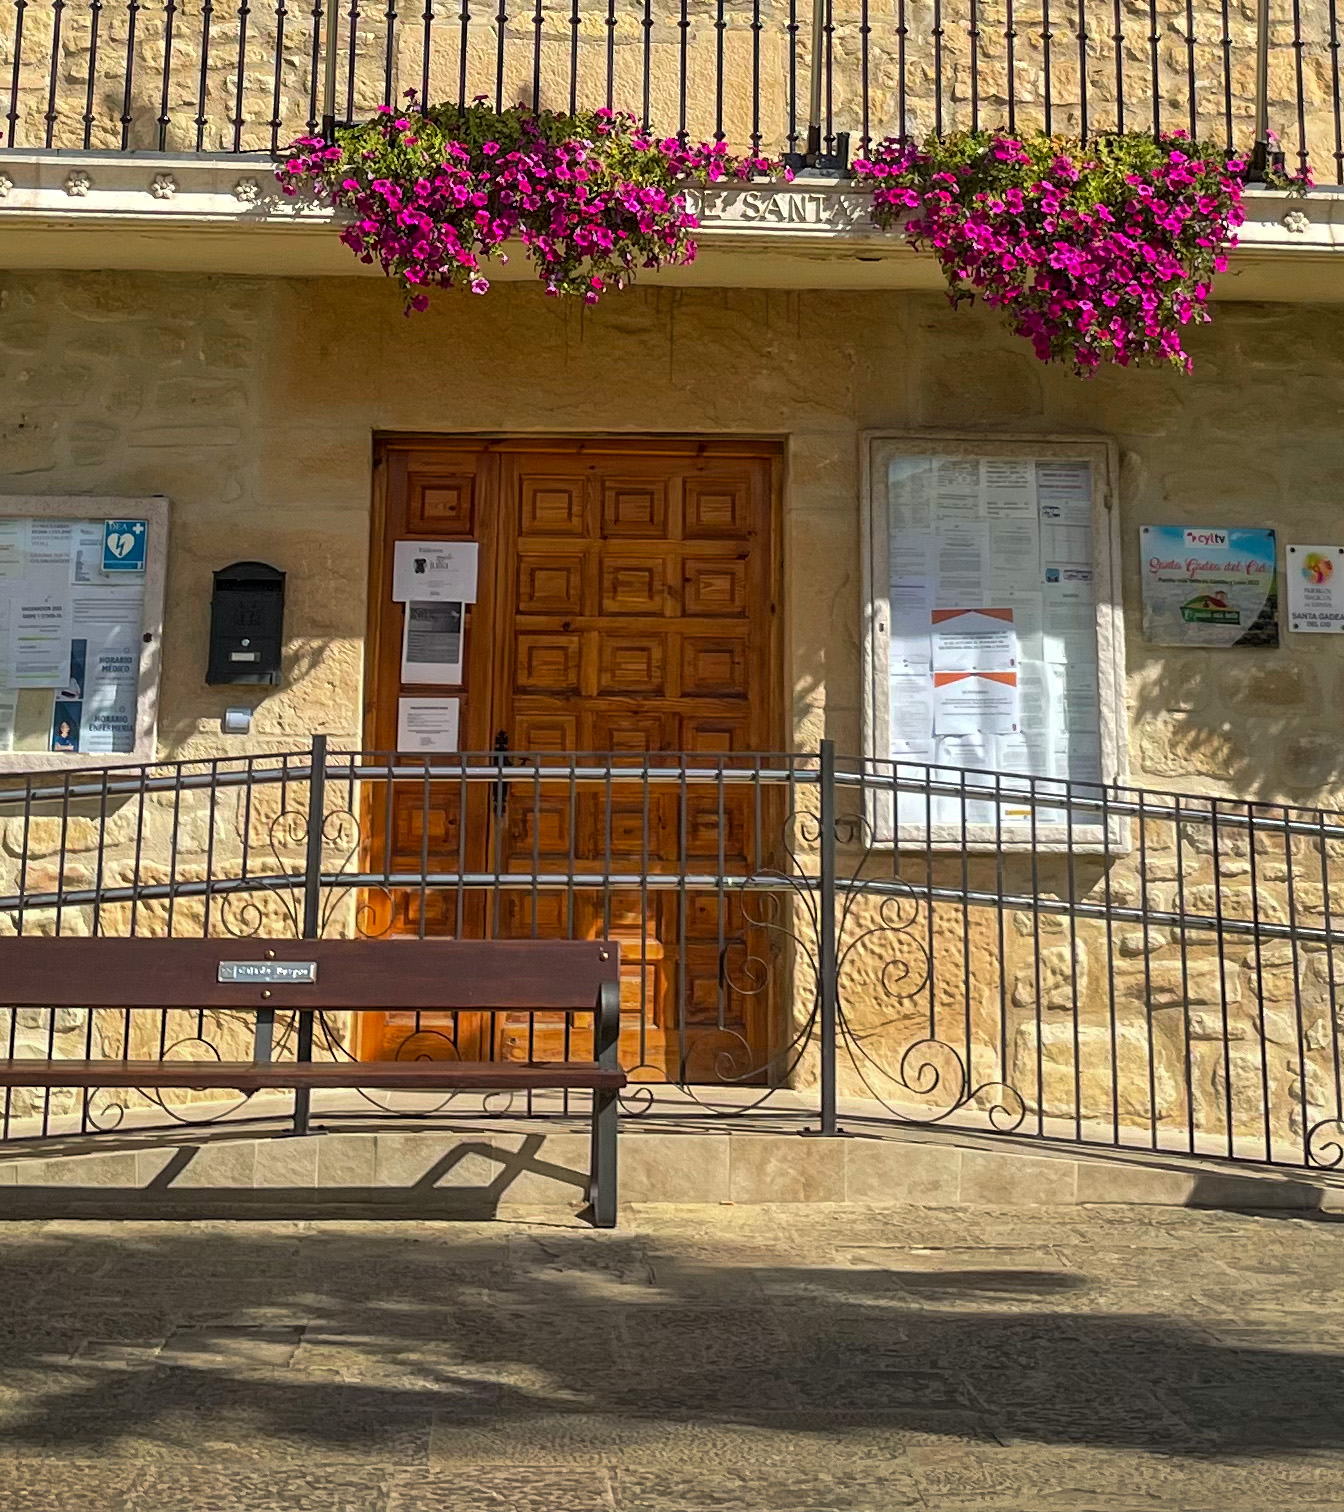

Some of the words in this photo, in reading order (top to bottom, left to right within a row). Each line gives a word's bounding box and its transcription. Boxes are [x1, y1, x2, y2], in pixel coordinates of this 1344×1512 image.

[109, 522, 128, 531] DEA
[1292, 612, 1317, 620] SANTA
[99, 656, 133, 664] HORARIO
